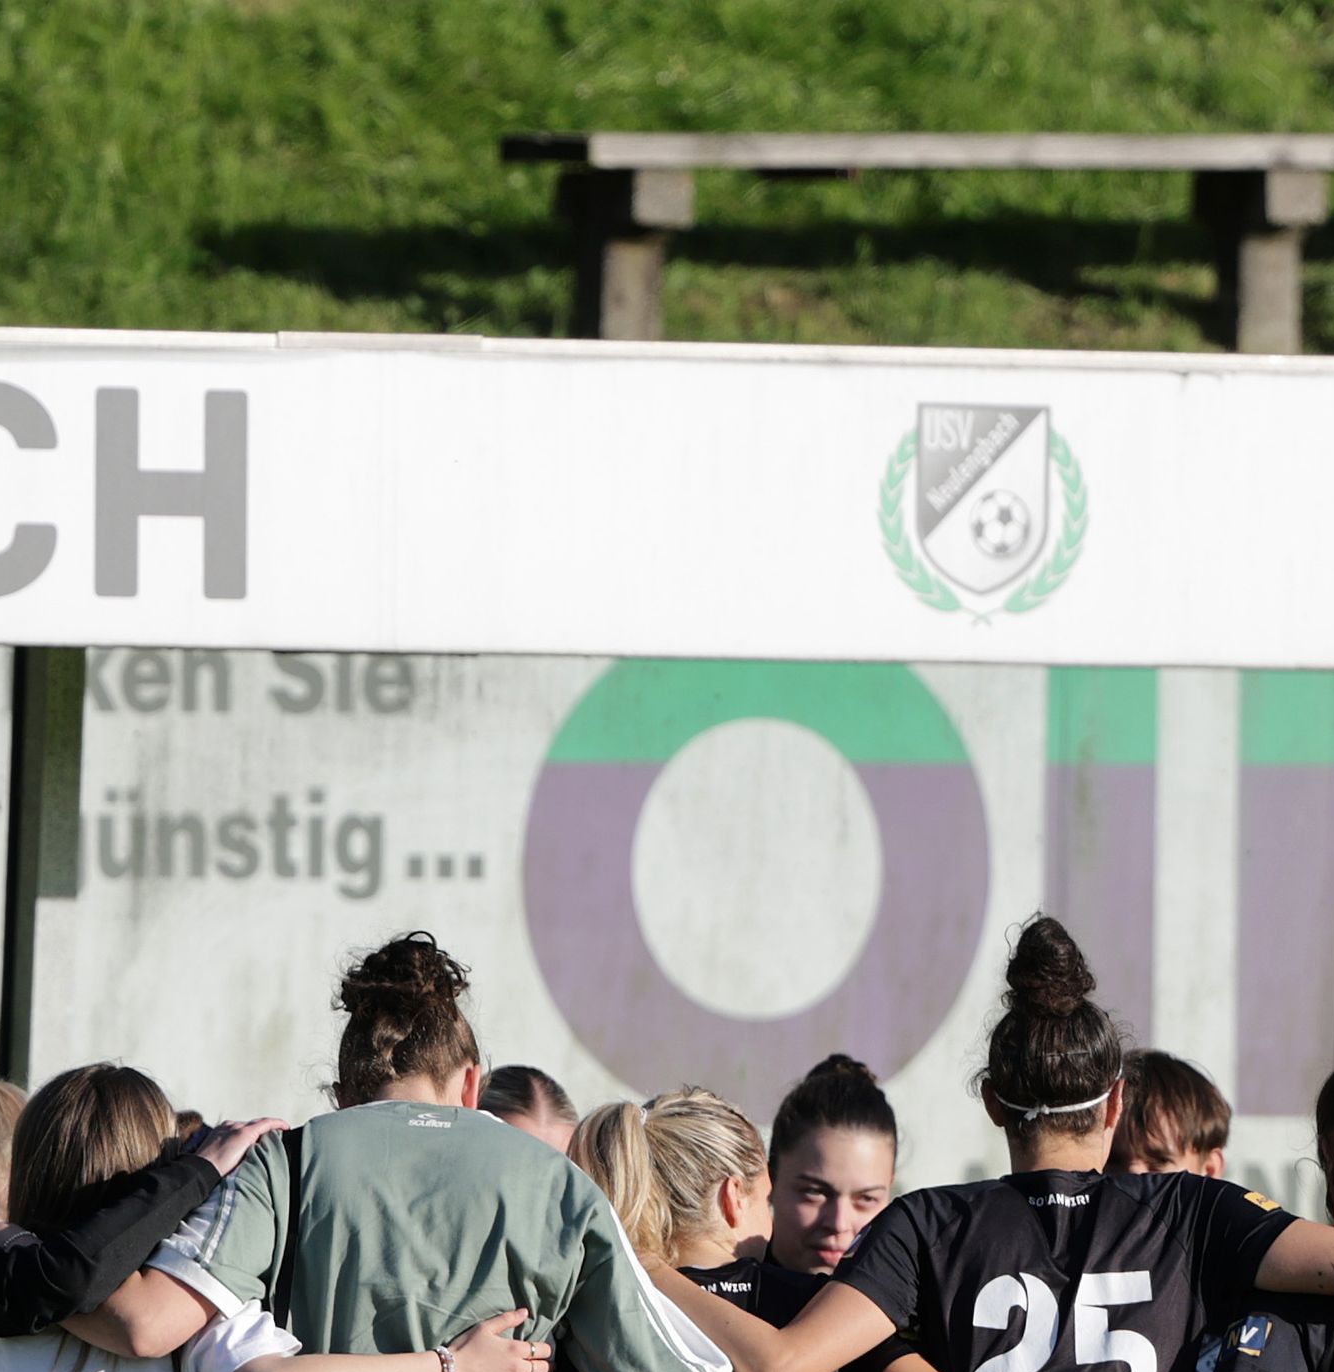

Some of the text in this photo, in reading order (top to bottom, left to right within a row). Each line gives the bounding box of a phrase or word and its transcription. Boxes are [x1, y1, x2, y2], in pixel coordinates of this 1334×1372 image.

[923, 411, 973, 450] USV
[269, 652, 416, 715] Sie
[719, 1281, 752, 1293] WIR!
